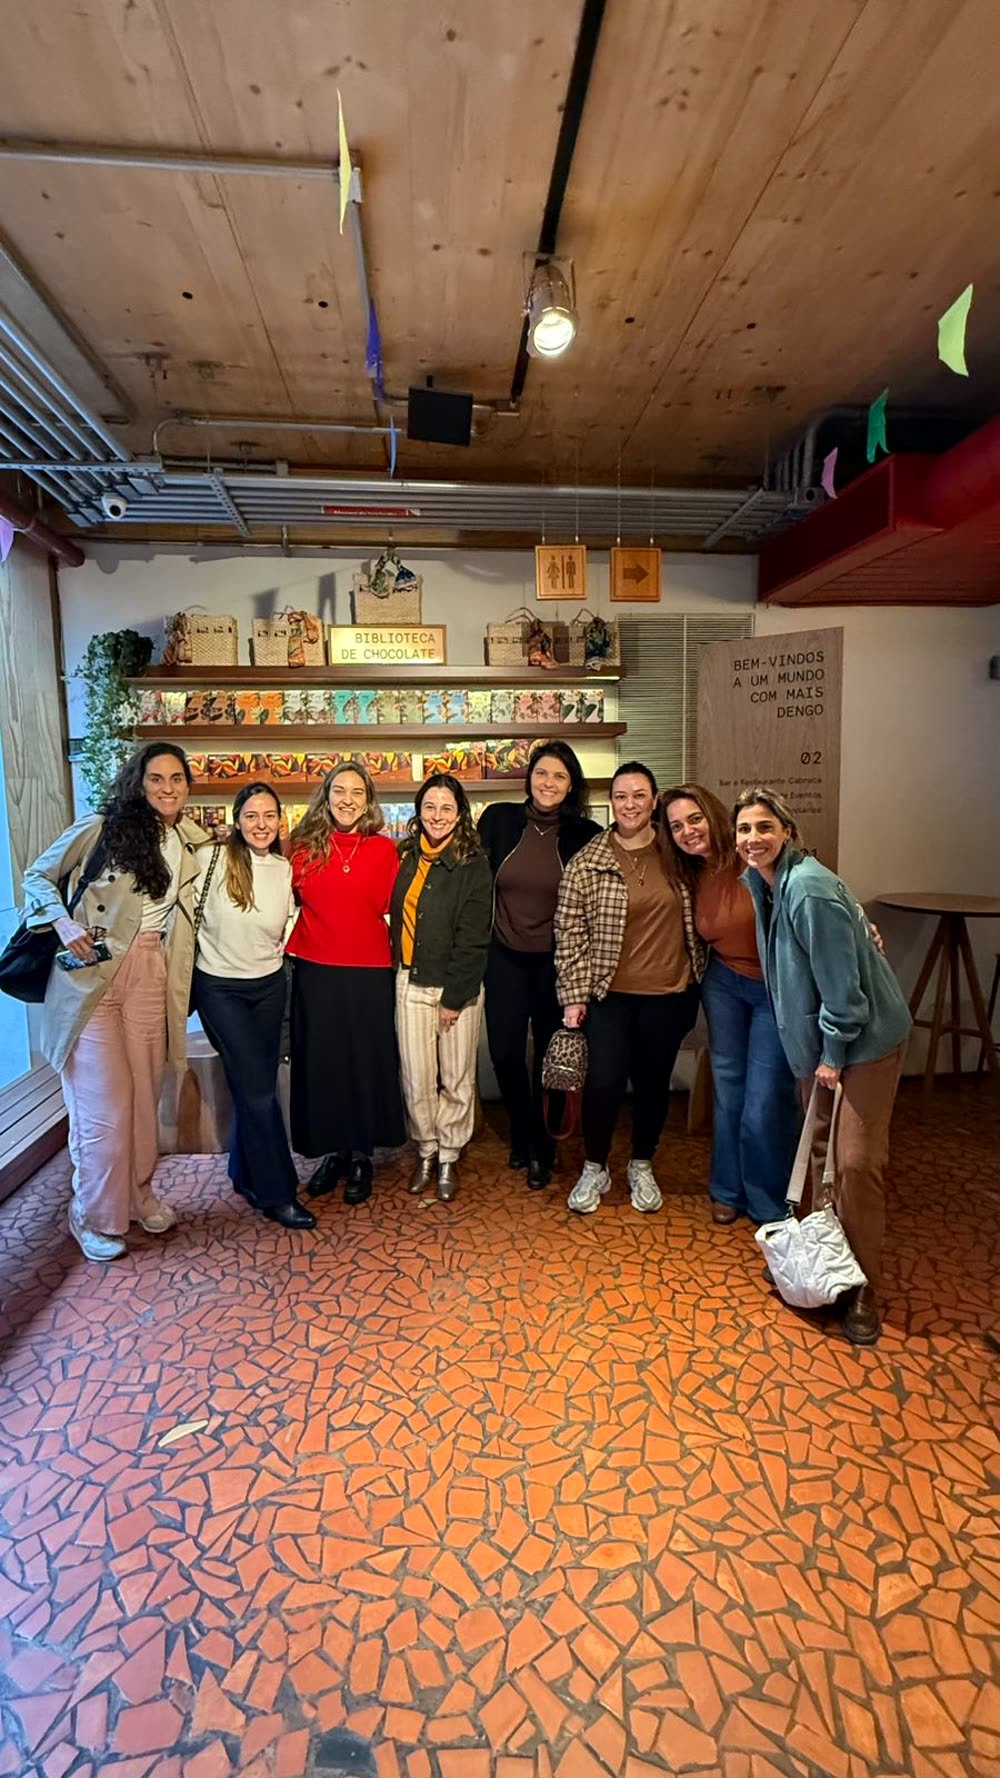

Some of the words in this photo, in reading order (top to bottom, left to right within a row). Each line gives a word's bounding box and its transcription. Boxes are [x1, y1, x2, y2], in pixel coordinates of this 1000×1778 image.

[355, 632, 436, 644] BIBLIOTECA
[341, 648, 357, 660] DE
[363, 648, 435, 660] CHOCOLATE
[733, 650, 825, 672] BEM-VINDOS
[732, 677, 742, 689] A
[750, 674, 769, 687] UM
[777, 668, 825, 684] MUNDO
[750, 691, 777, 704] COM
[786, 686, 824, 700] MAIS
[777, 703, 824, 719] DENGO
[801, 751, 822, 765] 02
